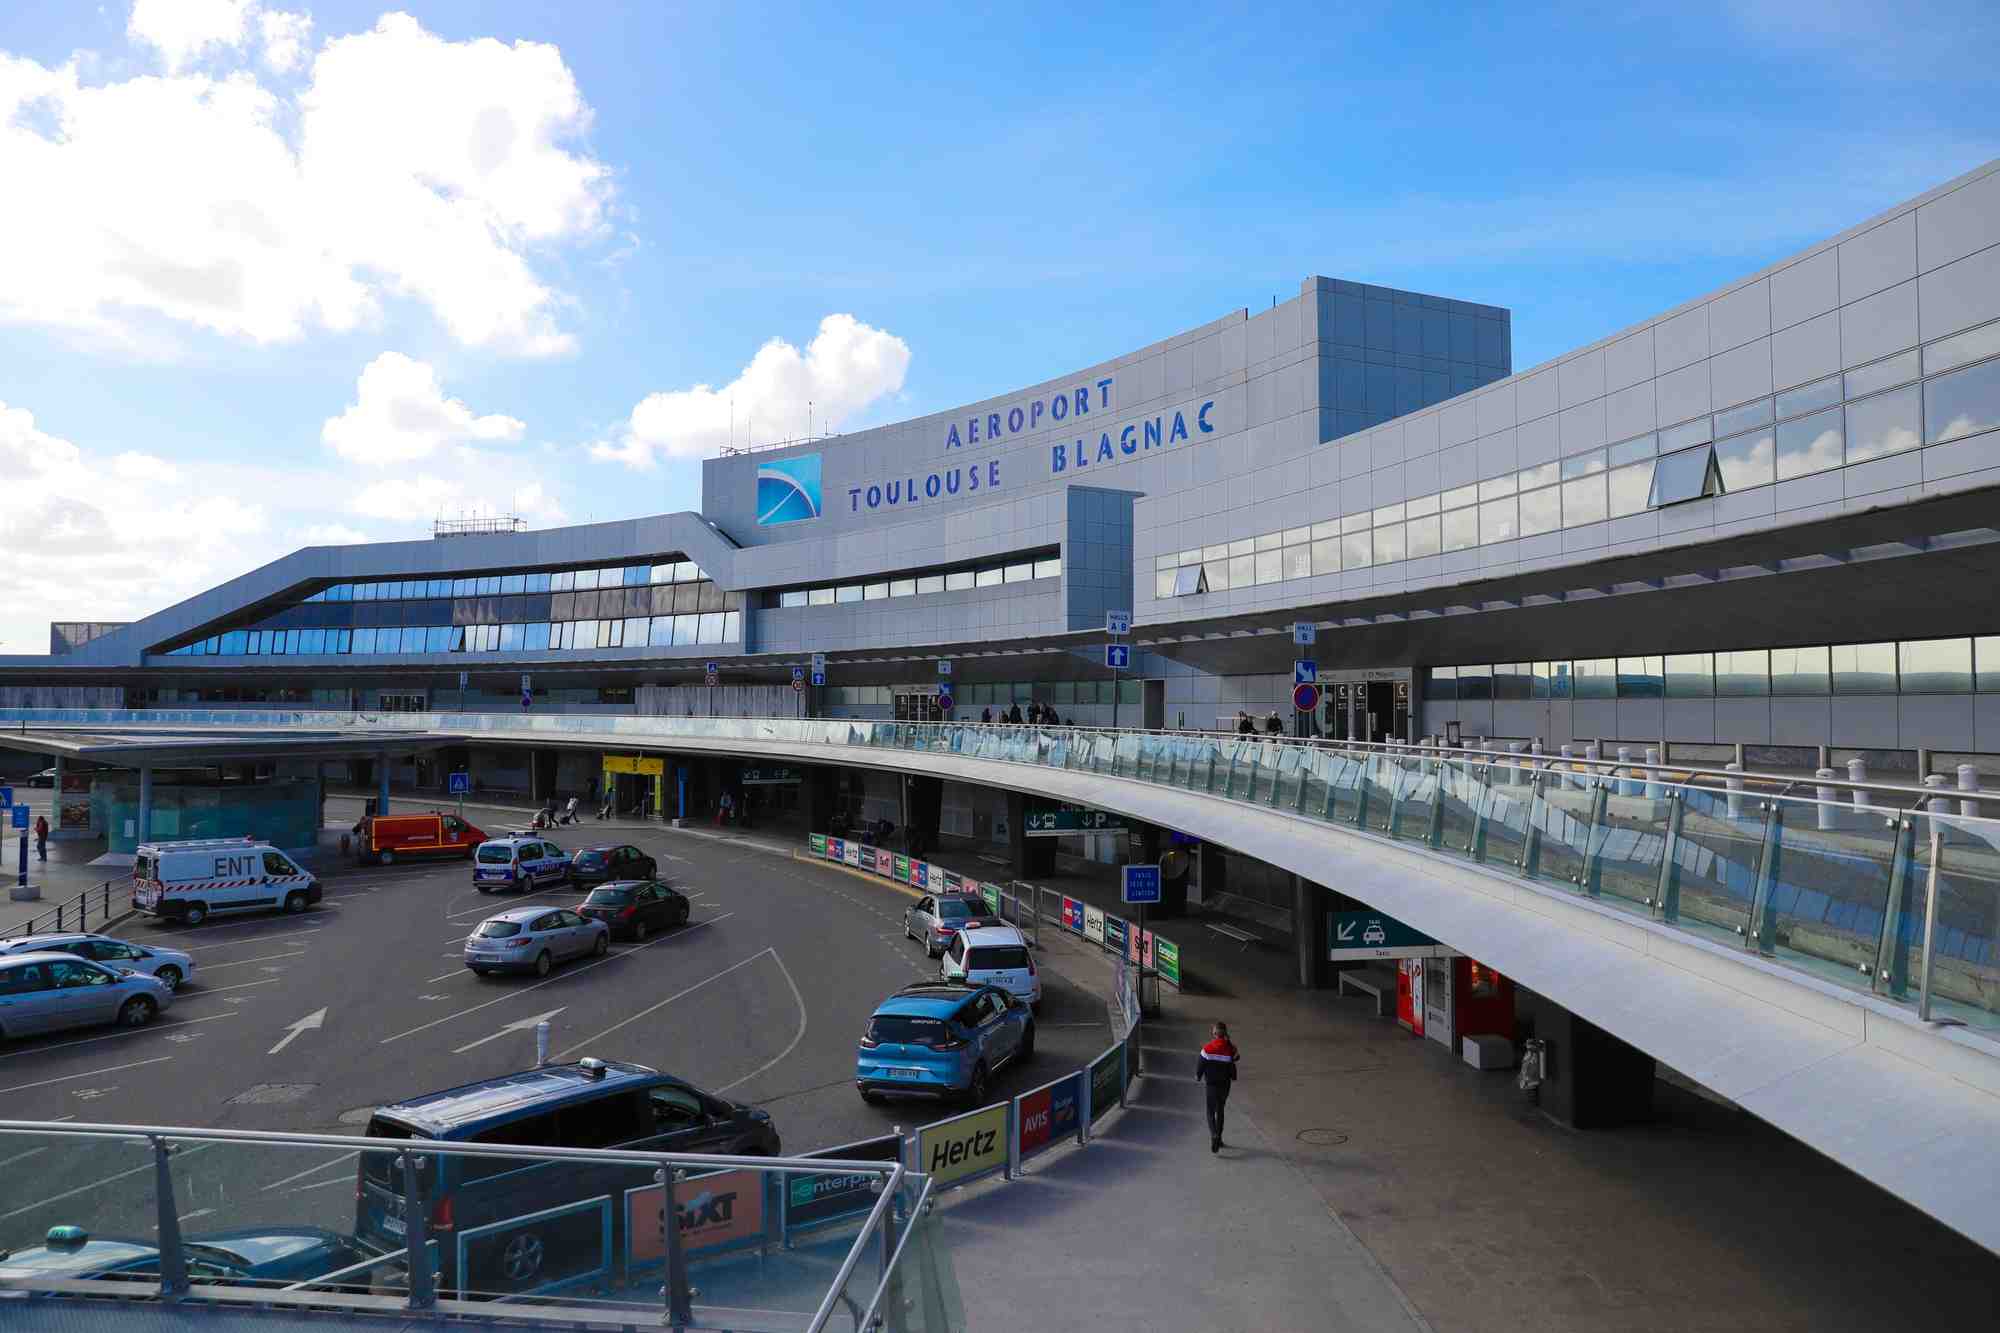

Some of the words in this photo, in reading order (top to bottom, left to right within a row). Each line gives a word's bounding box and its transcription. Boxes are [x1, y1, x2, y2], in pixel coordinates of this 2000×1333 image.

[945, 377, 1114, 449] AEROPORT
[848, 460, 1001, 512] TOULOUSE
[1052, 400, 1215, 473] BLAGNAC
[215, 856, 256, 877] ENT
[1024, 1110, 1048, 1135] AVIS
[931, 1129, 996, 1171] Hertz
